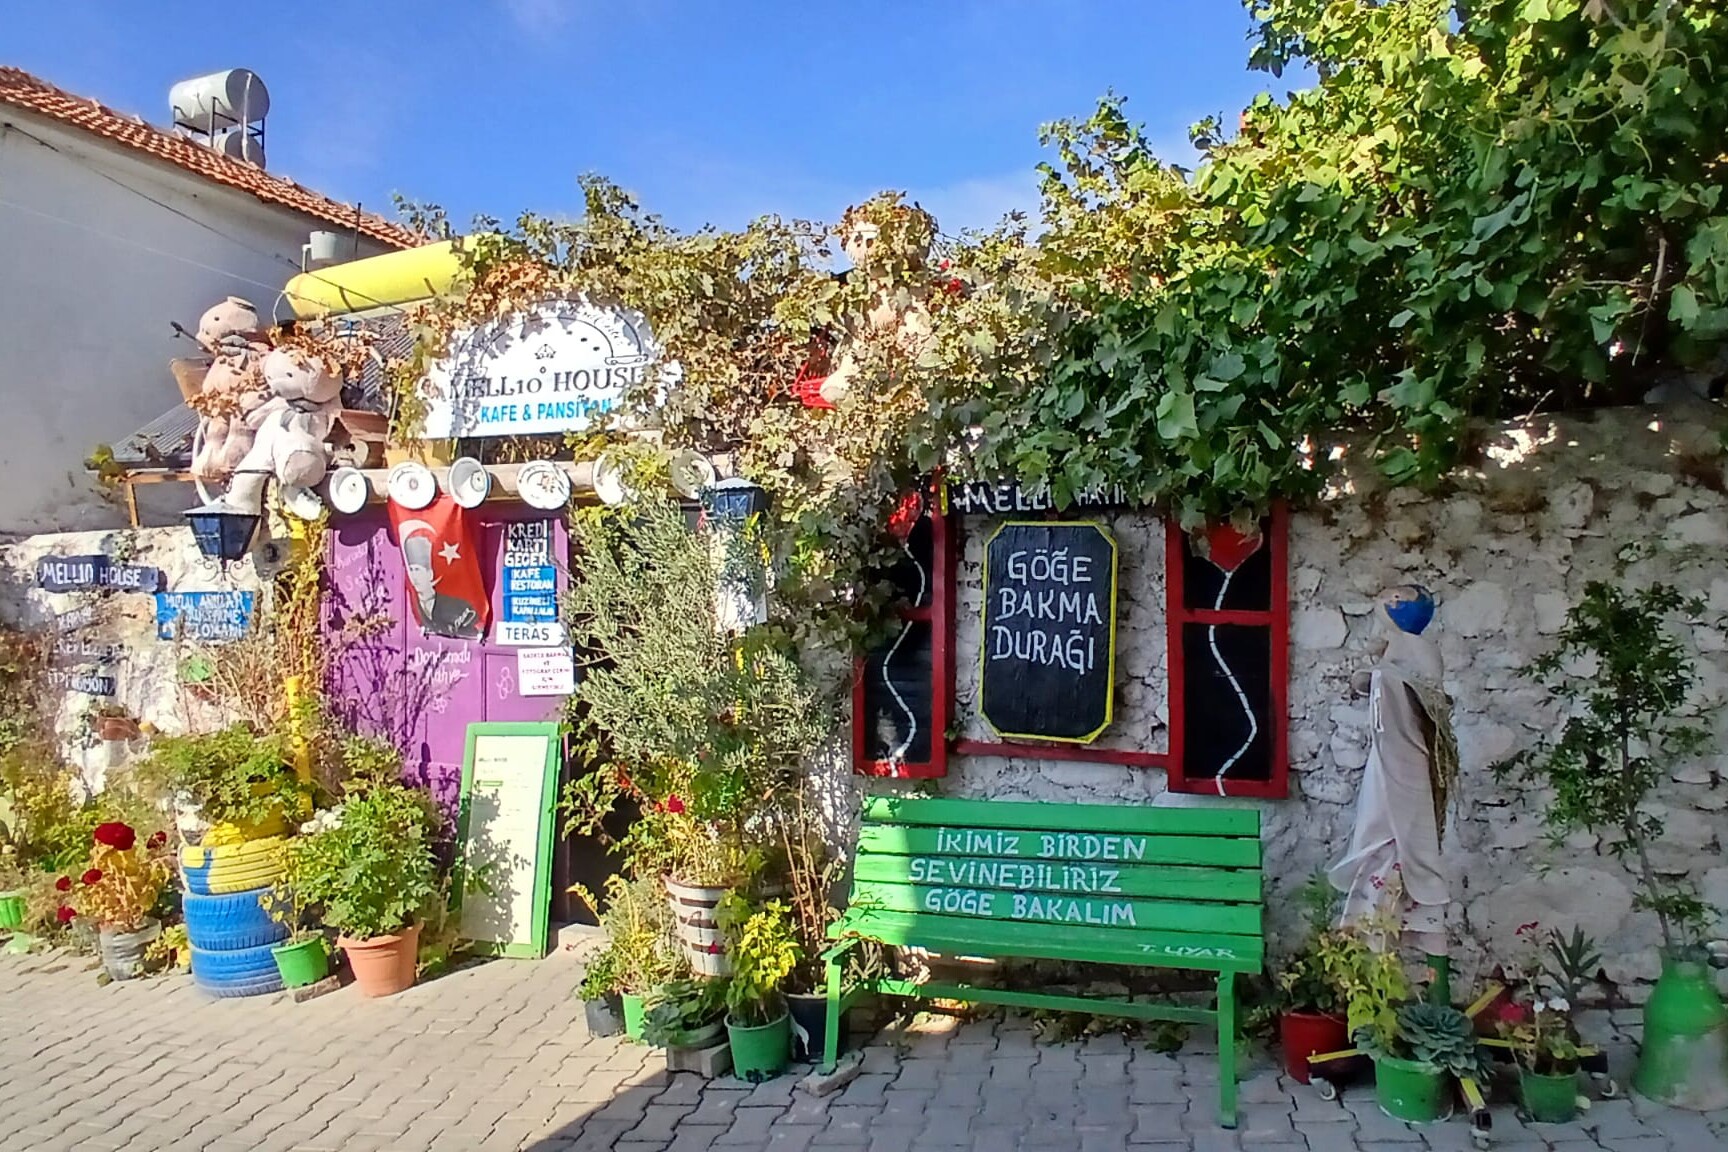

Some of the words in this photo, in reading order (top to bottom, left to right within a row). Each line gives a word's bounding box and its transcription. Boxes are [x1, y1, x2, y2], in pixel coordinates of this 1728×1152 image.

[481, 404, 517, 423] KAFE
[523, 403, 531, 421] &
[507, 538, 548, 553] KARTI
[100, 566, 142, 587] HOUSE
[512, 568, 541, 579] KAFE
[1007, 547, 1092, 585] GÖĞE
[995, 587, 1103, 624] BAKMA
[505, 627, 550, 641] TERAS
[992, 625, 1094, 675] DURAĞI
[937, 827, 1019, 854] İKİMİZ
[1037, 832, 1146, 859] BİRDEN
[908, 858, 1121, 892] SEVİNEBİLİRİZ
[1011, 894, 1137, 926] BAKALIM
[1164, 946, 1236, 959] UYAR
